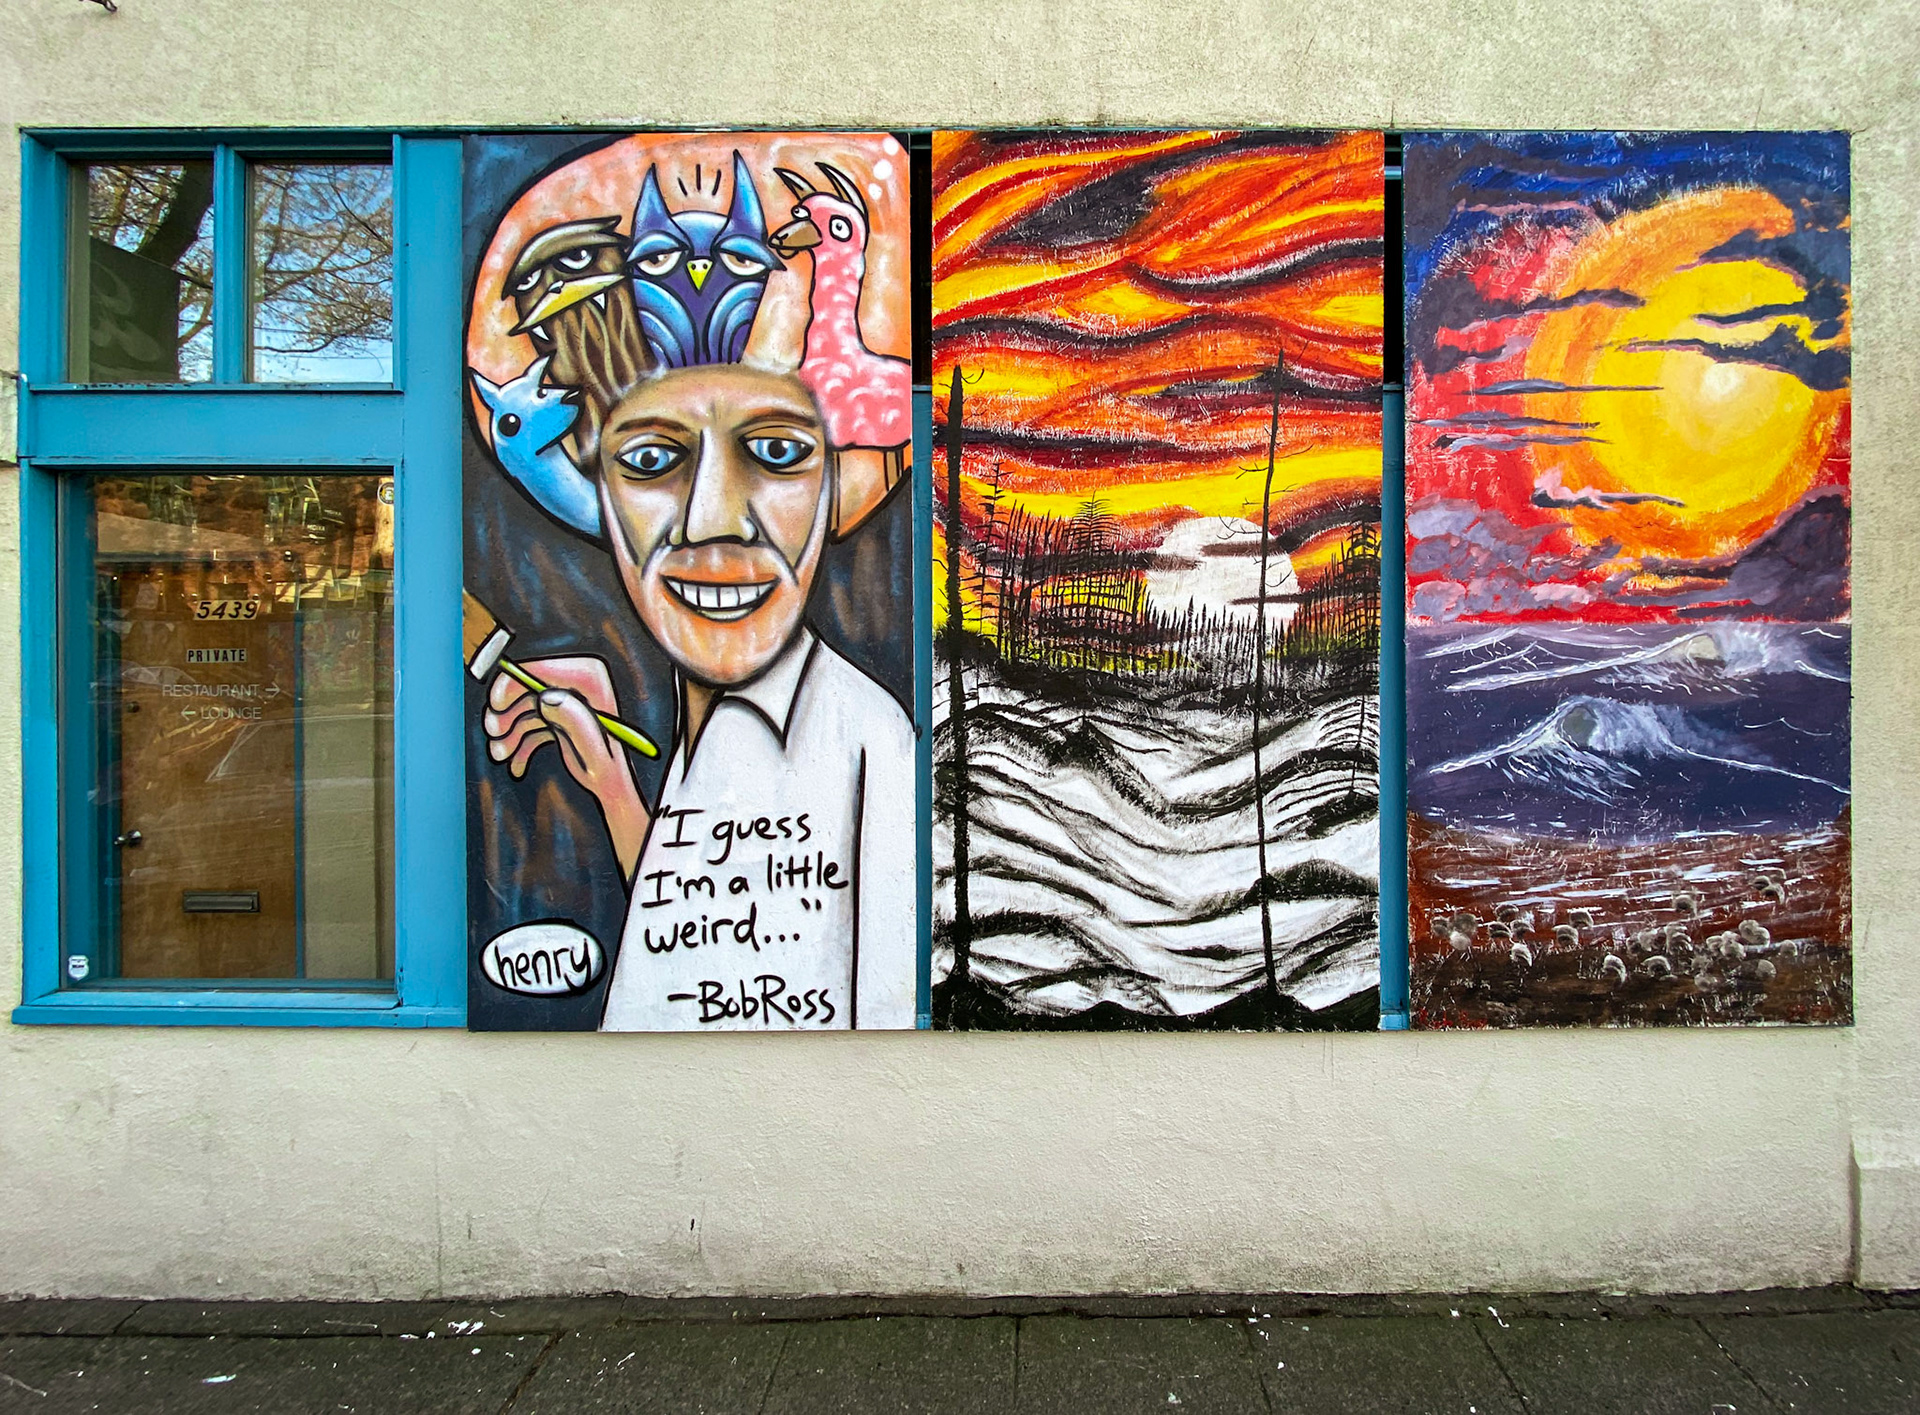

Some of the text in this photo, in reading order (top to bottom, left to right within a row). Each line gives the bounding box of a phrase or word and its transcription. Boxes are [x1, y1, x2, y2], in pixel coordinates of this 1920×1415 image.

[197, 601, 258, 619] 5439
[188, 650, 245, 662] PRIVATE
[162, 684, 260, 697] RESTAURANT
[201, 707, 262, 719] LOUNGE
[707, 813, 811, 865] guess
[641, 850, 849, 908] I'm a little
[494, 938, 592, 993] henry
